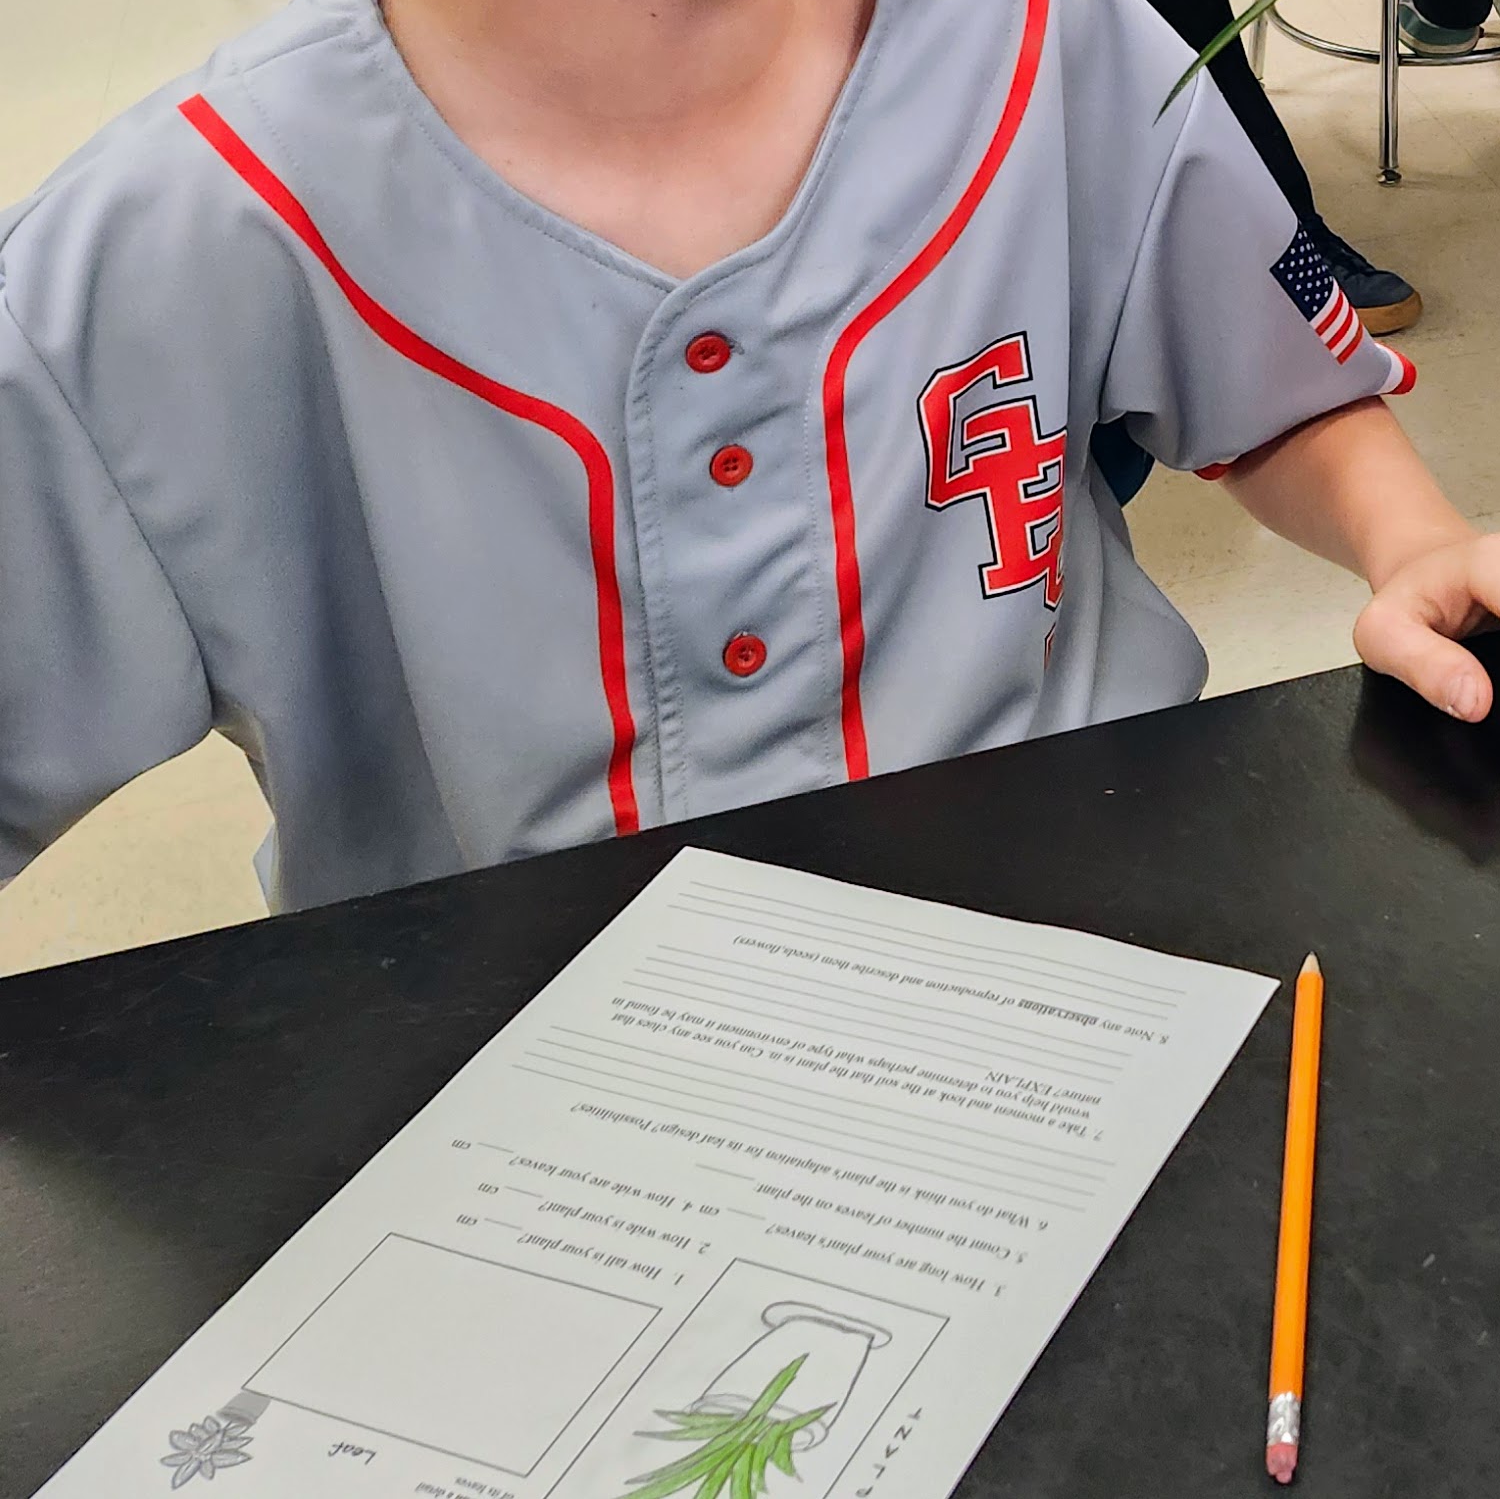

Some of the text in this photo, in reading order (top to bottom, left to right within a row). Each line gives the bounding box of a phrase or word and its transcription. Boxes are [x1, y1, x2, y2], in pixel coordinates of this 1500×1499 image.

[733, 935, 820, 962] (seeds,flowers)
[821, 956, 850, 970] them
[851, 964, 899, 981] describe
[898, 975, 924, 985] and
[925, 981, 1000, 1002] reproduction
[997, 997, 1015, 1005] of
[611, 1013, 635, 1026] that
[1017, 999, 1099, 1026] observations
[636, 1019, 667, 1033] clues
[668, 1025, 692, 1037] any
[1099, 1020, 1122, 1031] any
[692, 1033, 714, 1043] see
[1124, 1027, 1155, 1041] Note
[714, 1038, 741, 1050] you
[739, 1044, 764, 1058] Can
[612, 997, 1089, 1119] would help you to determine perhaps what type of environment it may be found in
[783, 1055, 796, 1064] is
[796, 1058, 830, 1072] plant
[829, 1066, 849, 1077] the
[849, 1071, 875, 1083] that
[874, 1077, 899, 1087] soil
[901, 1082, 922, 1094] the
[984, 1071, 1101, 1105] nature? EXPLAIN
[922, 1088, 937, 1096] at
[938, 1091, 966, 1106] look
[966, 1099, 992, 1110] and
[570, 1103, 653, 1131] Possibilities?
[993, 1105, 1045, 1123] moment
[651, 1123, 700, 1141] design?
[1058, 1122, 1087, 1137] Take
[452, 1139, 471, 1150] cm
[696, 1134, 726, 1148] leaf
[726, 1140, 743, 1152] its
[744, 1145, 765, 1158] for
[509, 1156, 558, 1176] leaves?
[765, 1150, 832, 1174] adaptation
[557, 1168, 591, 1182] your
[833, 1169, 877, 1186] plant's
[589, 1177, 611, 1188] are
[875, 1180, 897, 1193] the
[611, 1183, 641, 1197] wide
[899, 1185, 911, 1195] is
[914, 1189, 947, 1205] think
[642, 1192, 676, 1208] How
[792, 1194, 814, 1207] the
[815, 1199, 833, 1210] on
[948, 1197, 975, 1210] you
[478, 1183, 691, 1249] How wide is your plant? cm
[699, 1205, 720, 1216] cm
[834, 1205, 876, 1224] leaves
[976, 1205, 993, 1217] do
[872, 1215, 892, 1226] of
[995, 1209, 1029, 1229] What
[765, 1223, 817, 1245] leaves?
[893, 1219, 945, 1239] number
[456, 1214, 663, 1280] How tall is your plant? cm
[818, 1237, 863, 1255] plant's
[946, 1233, 968, 1247] the
[862, 1248, 896, 1264] your
[968, 1239, 1011, 1259] Count
[895, 1258, 918, 1270] are
[918, 1262, 949, 1282] long
[951, 1274, 986, 1292] How
[327, 1441, 376, 1465] Leaf
